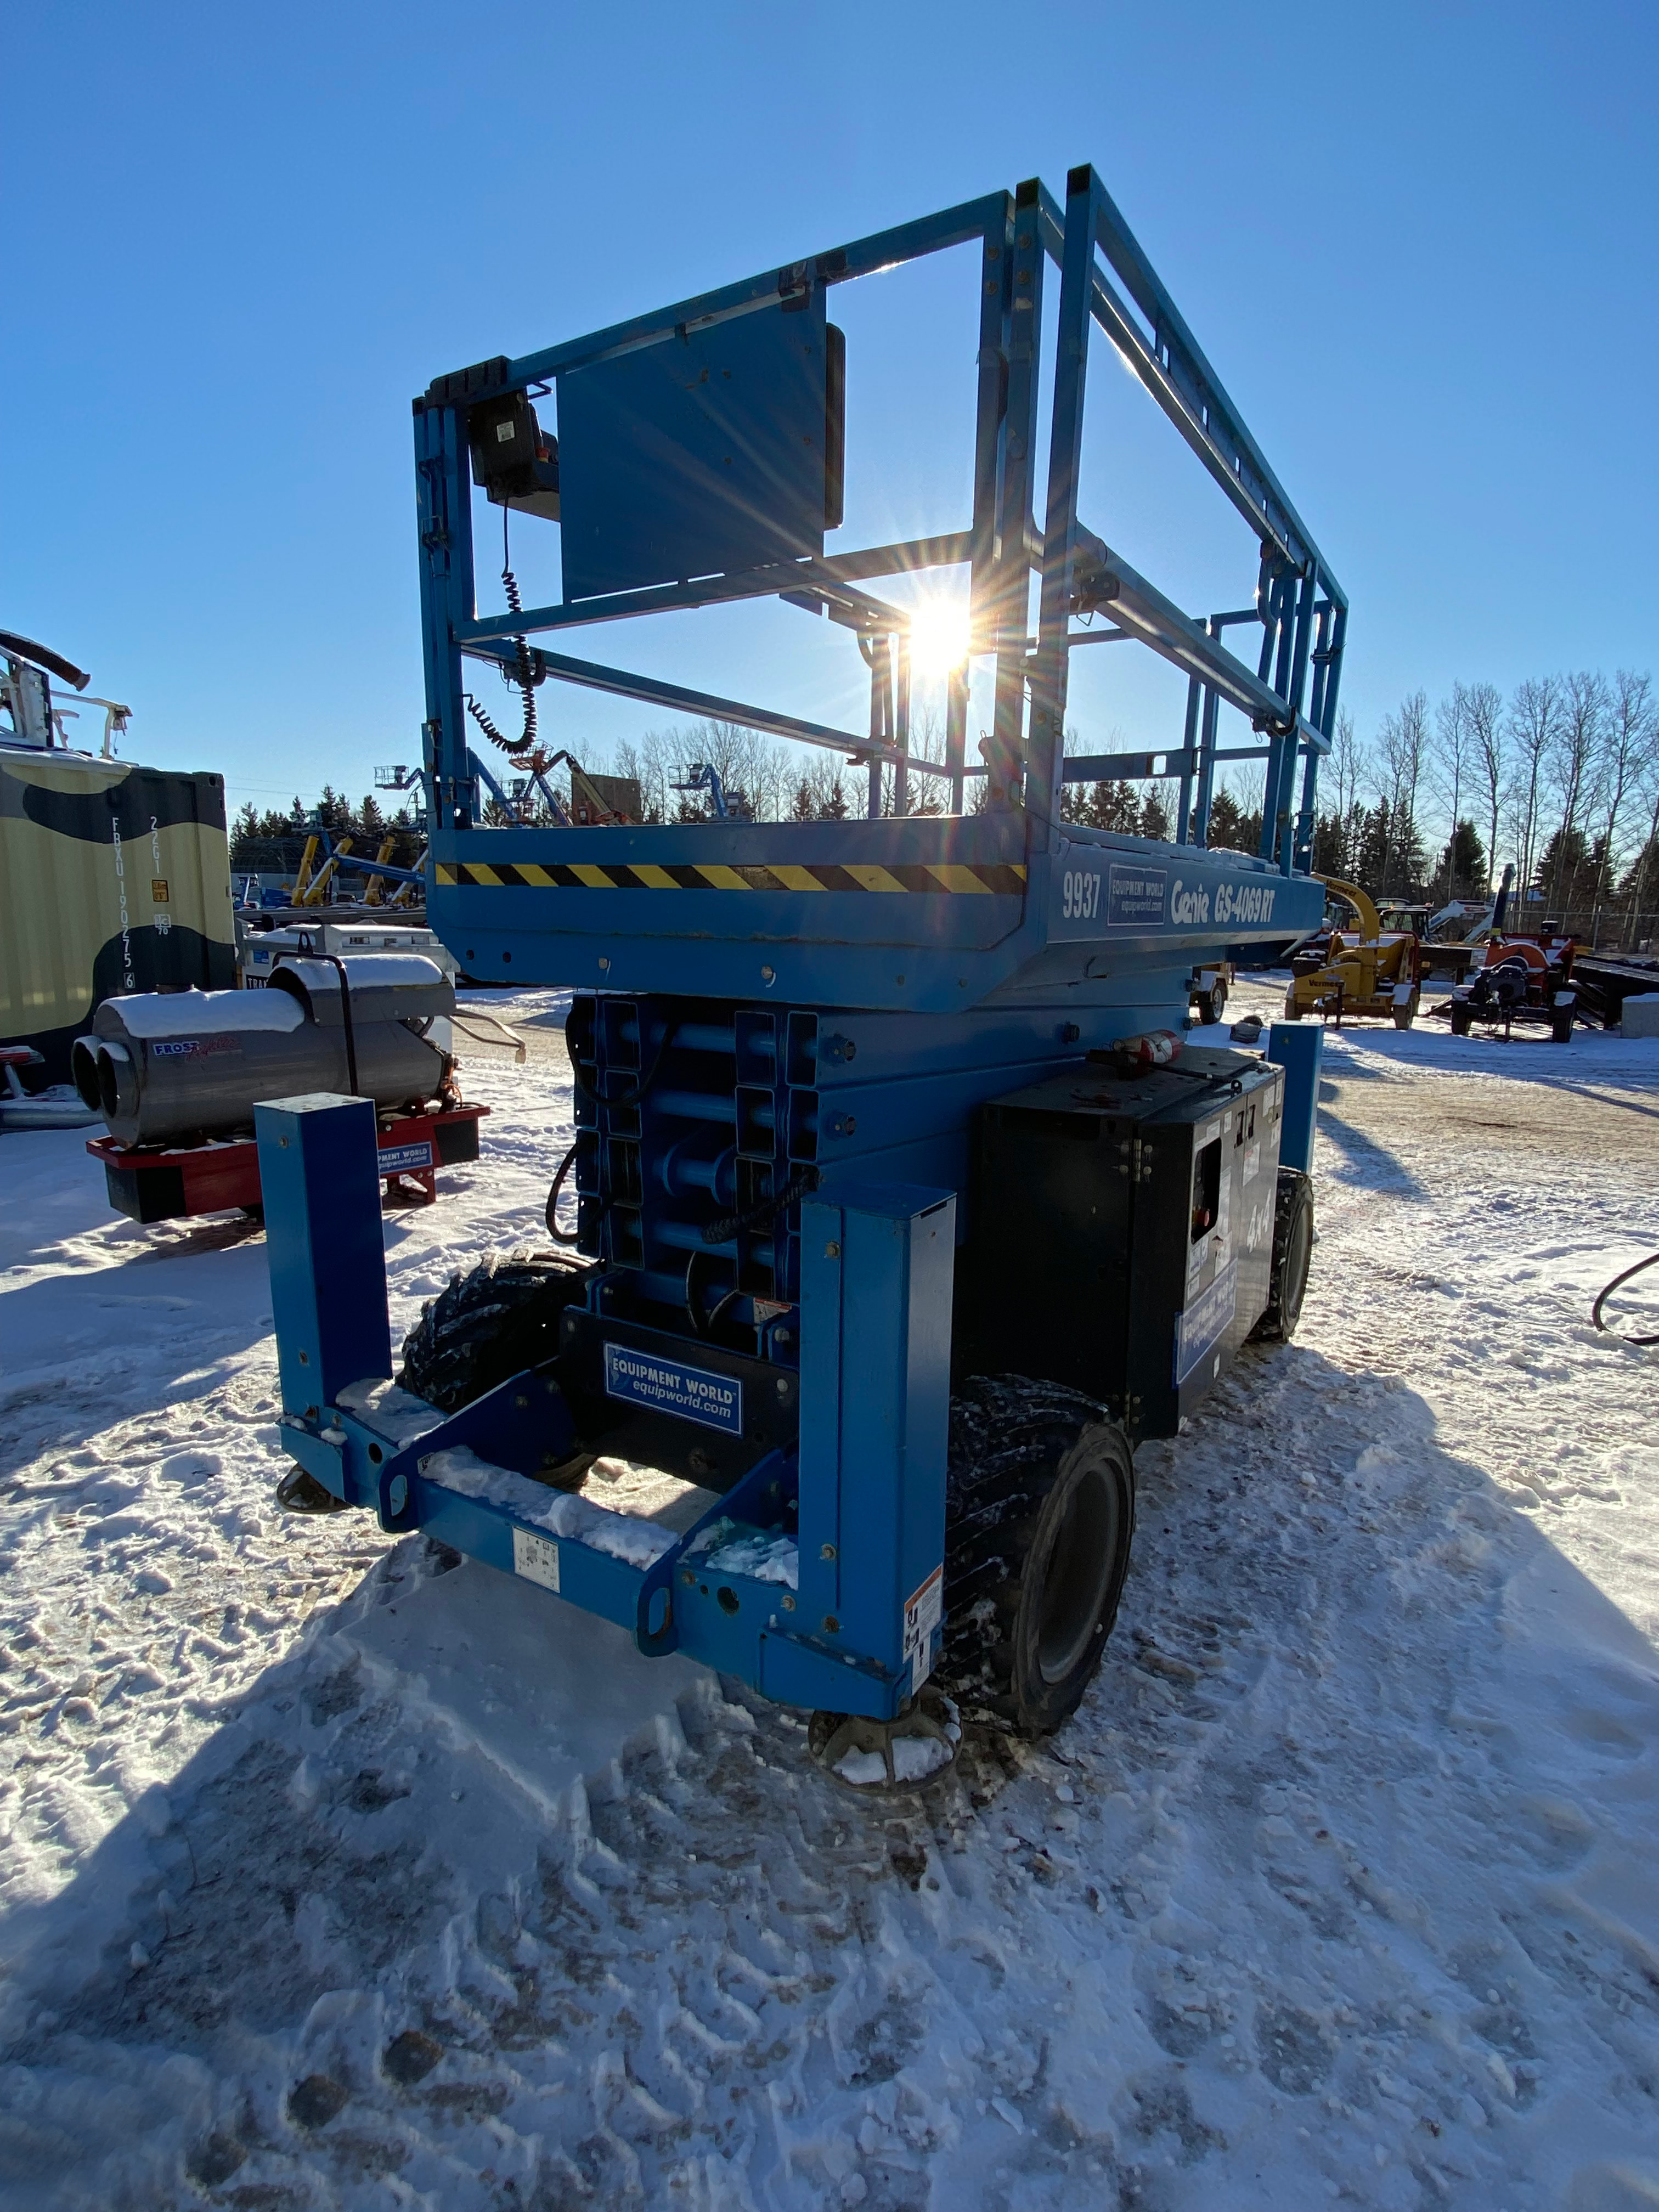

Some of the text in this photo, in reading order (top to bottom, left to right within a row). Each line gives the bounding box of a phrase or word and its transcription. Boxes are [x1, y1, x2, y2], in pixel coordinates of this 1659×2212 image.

[150, 816, 160, 873] 22G1
[112, 817, 133, 988] FBXU 190275 6
[1063, 871, 1101, 918] 9937
[1113, 879, 1163, 897] EQUIPMENT WORLD
[1171, 880, 1209, 924] Genie
[155, 1042, 199, 1055] FROST
[403, 1148, 427, 1157] WORLD
[613, 1358, 732, 1404] EQUIPMENT WORLD
[633, 1380, 731, 1419] equipworld.com
